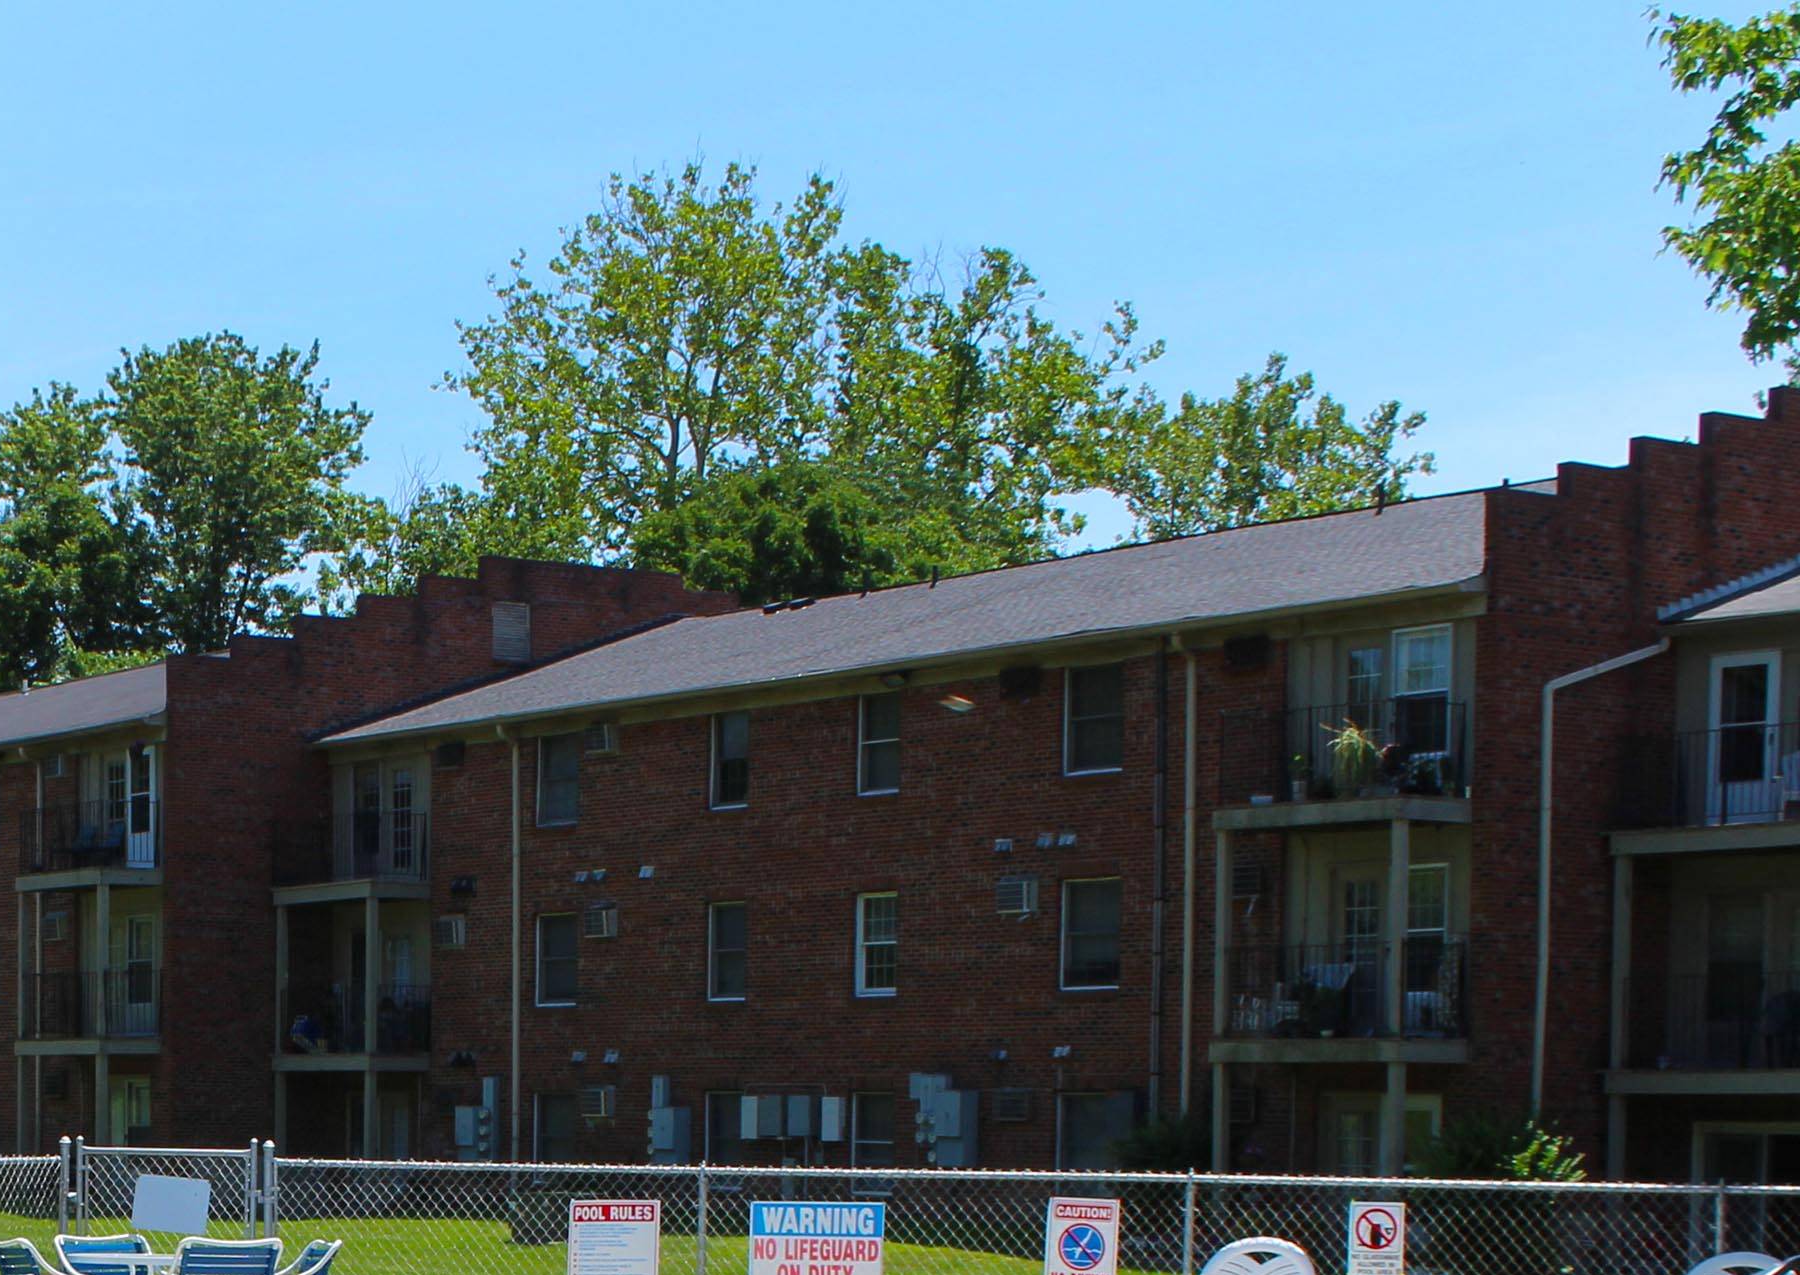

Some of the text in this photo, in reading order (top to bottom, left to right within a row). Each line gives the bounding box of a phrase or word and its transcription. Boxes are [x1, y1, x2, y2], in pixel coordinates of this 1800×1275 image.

[575, 1206, 652, 1221] POOL RULES
[761, 1206, 875, 1235] WARNING
[1056, 1206, 1111, 1219] CAUTION!
[753, 1238, 879, 1262] NO LIFEGUARD
